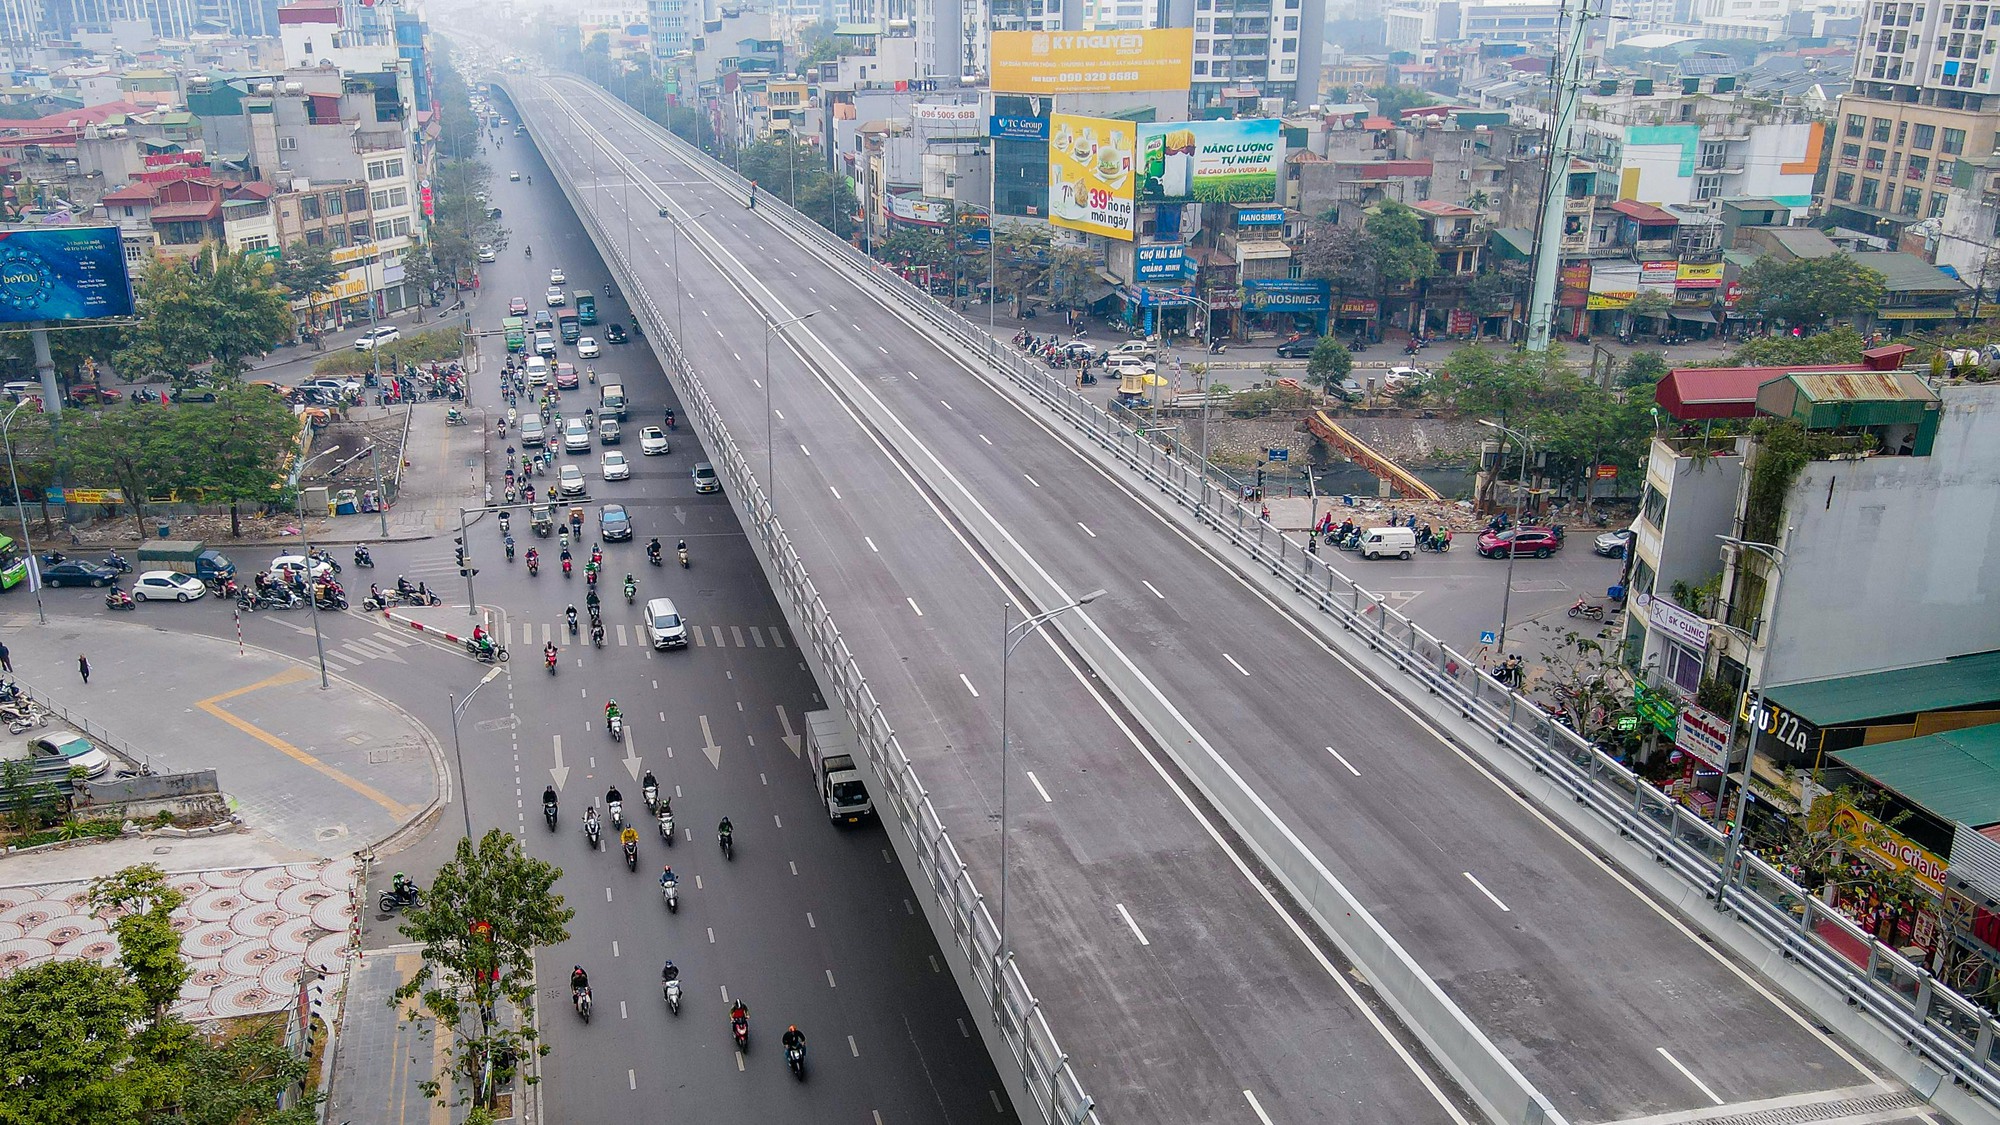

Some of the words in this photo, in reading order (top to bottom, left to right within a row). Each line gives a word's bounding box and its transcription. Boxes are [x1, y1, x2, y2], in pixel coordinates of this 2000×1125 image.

[921, 110, 935, 118] 096
[937, 111, 955, 119] 5005
[957, 111, 975, 119] 688
[1008, 119, 1018, 128] TC
[1020, 119, 1043, 131] Group
[1202, 142, 1234, 154] NĂNG
[1236, 142, 1274, 154] LƯỢNG
[1237, 154, 1271, 164] NHIÊN
[1108, 213, 1129, 229] ngày
[1239, 213, 1283, 222] HANOSIMEX
[1140, 249, 1155, 261] CHỢ
[1155, 246, 1168, 259] HẢI
[1169, 246, 1183, 259] SẢN
[1141, 262, 1163, 273] QUẢNG
[2, 273, 38, 284] beYOU
[1668, 615, 1681, 628] SK
[1680, 621, 1706, 640] CLINIC
